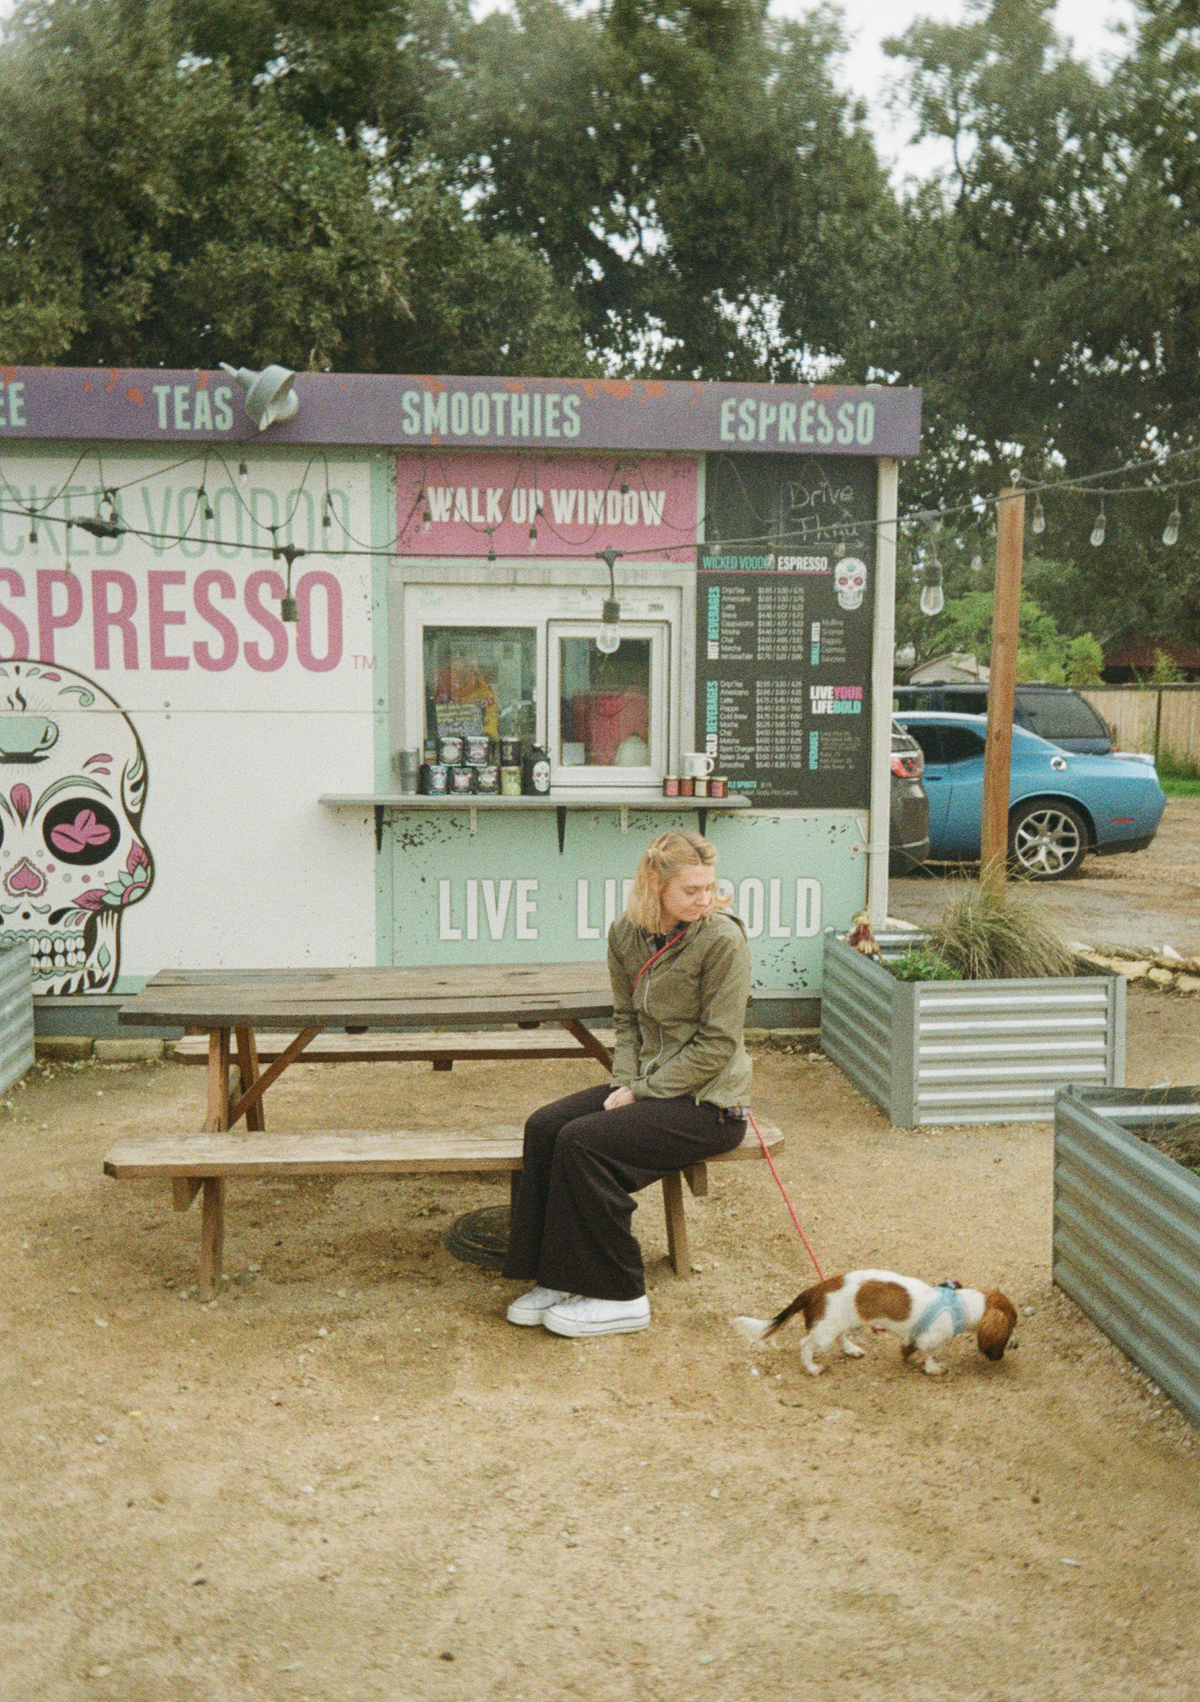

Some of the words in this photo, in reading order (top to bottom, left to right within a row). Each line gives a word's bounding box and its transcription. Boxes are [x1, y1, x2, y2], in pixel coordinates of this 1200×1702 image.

[152, 385, 234, 431] TEAS
[402, 390, 582, 439] SMOOTHIES
[720, 398, 875, 447] ESPRESSO
[427, 487, 502, 524] WALK
[511, 487, 545, 524] UP
[547, 488, 667, 526] WINDOW
[788, 480, 854, 509] Drive
[141, 486, 351, 560] VOODOO
[703, 555, 737, 570] WICKED
[778, 555, 828, 571] ESPRESSO
[708, 586, 720, 640] BEVERAGES
[351, 655, 378, 670] TM
[706, 680, 718, 733] BEVERAGES
[706, 733, 718, 758] COLD
[438, 878, 539, 941] LIVE
[576, 878, 633, 941] LI
